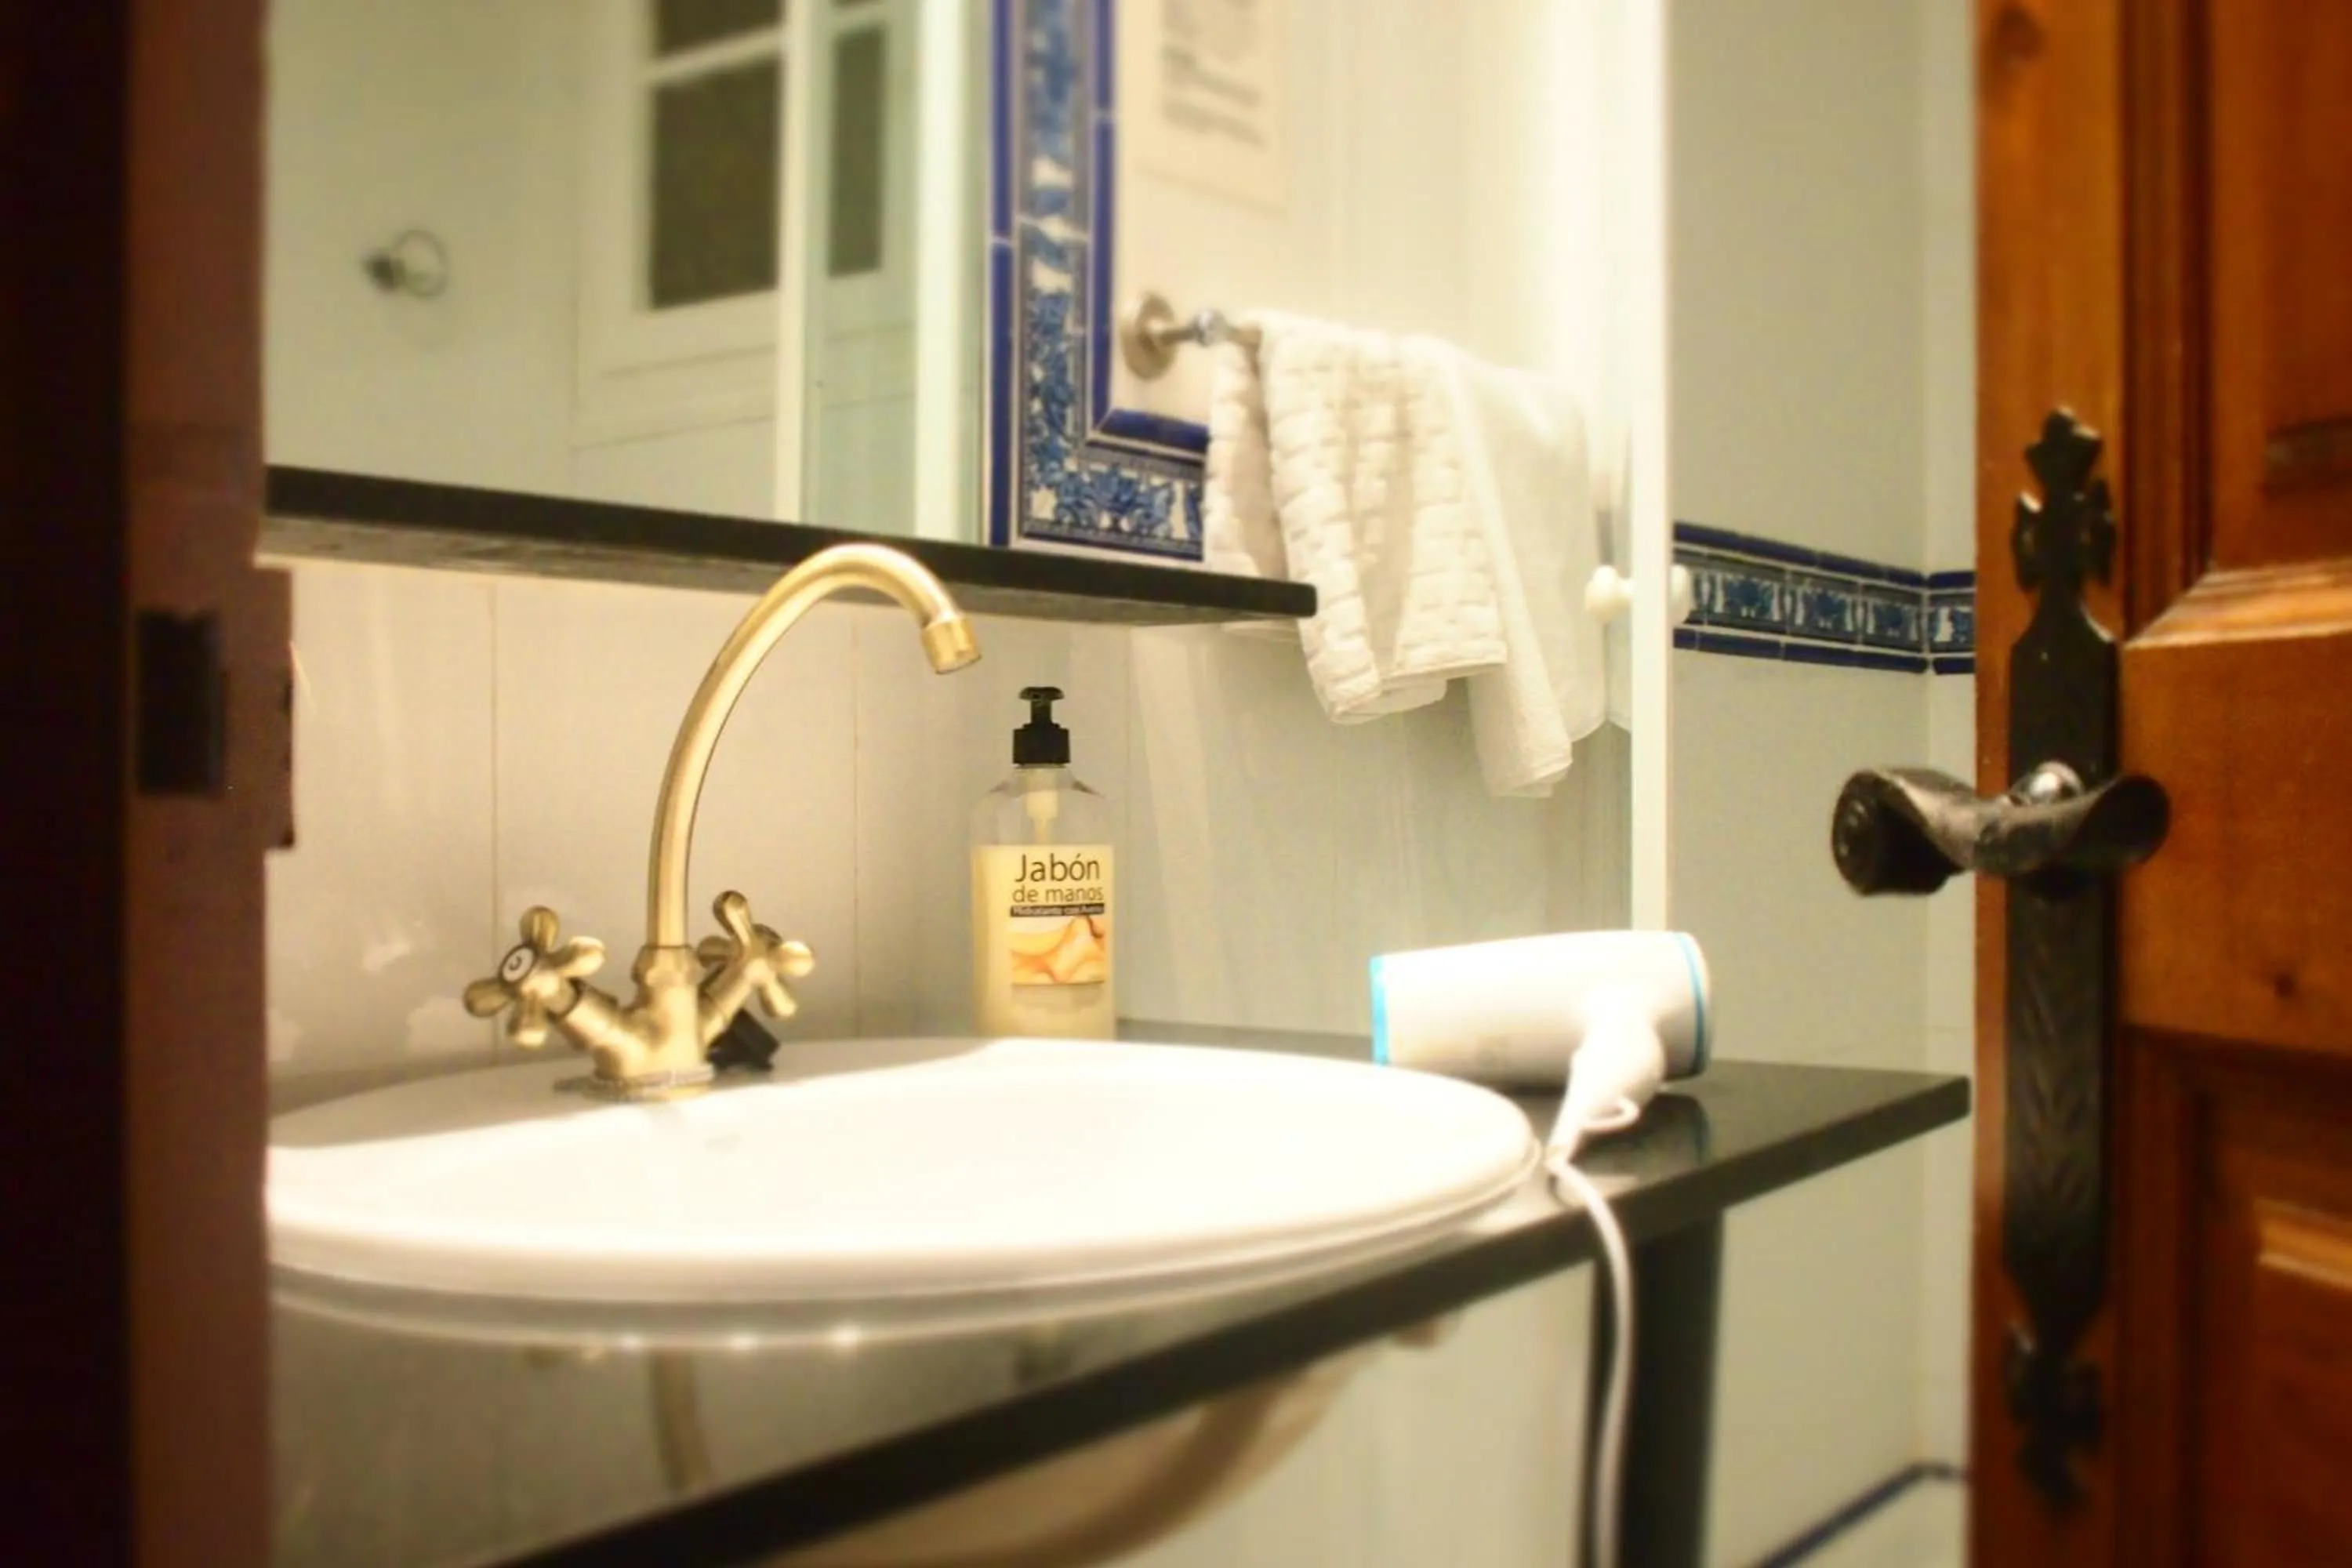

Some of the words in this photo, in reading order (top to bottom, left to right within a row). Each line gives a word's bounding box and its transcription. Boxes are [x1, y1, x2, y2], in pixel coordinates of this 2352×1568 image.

[1014, 853, 1100, 882] Jabón
[1012, 886, 1039, 902] de
[1045, 887, 1105, 903] manos
